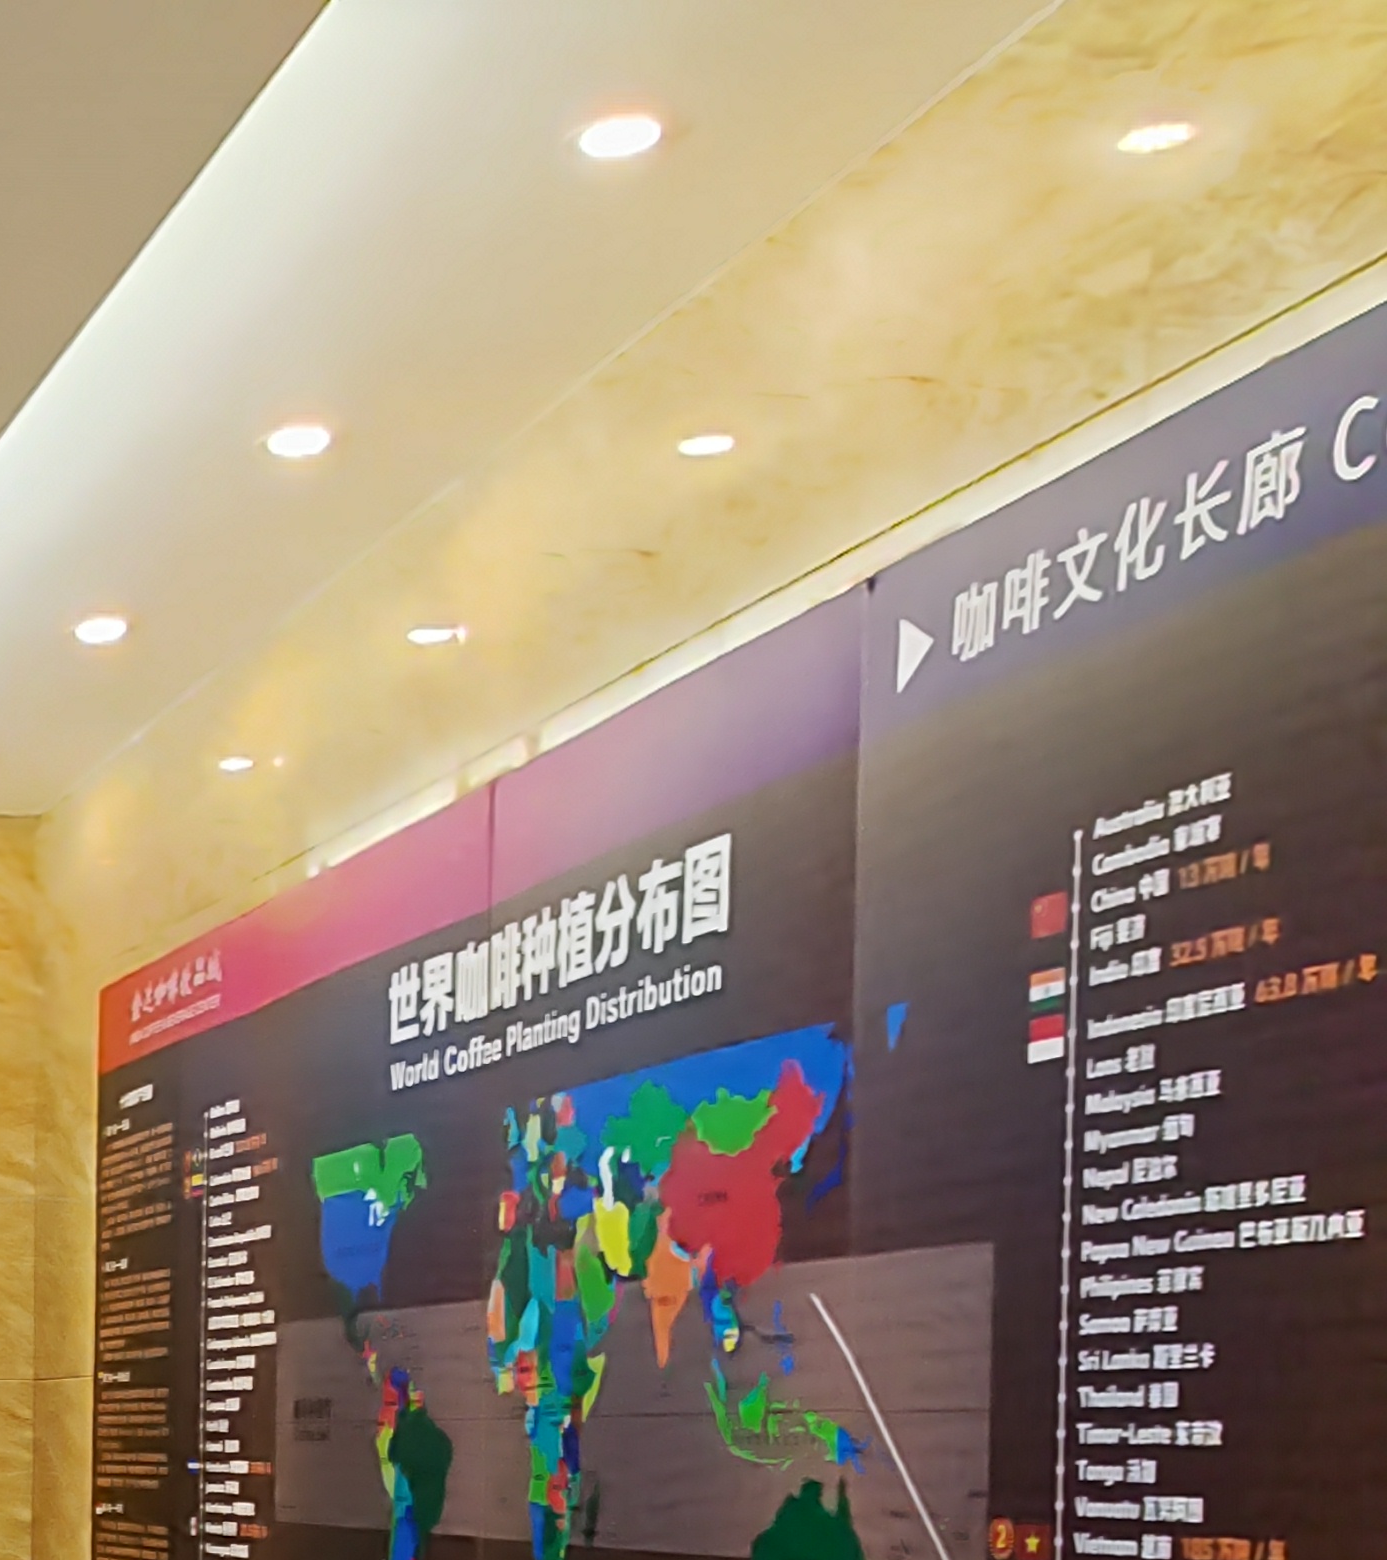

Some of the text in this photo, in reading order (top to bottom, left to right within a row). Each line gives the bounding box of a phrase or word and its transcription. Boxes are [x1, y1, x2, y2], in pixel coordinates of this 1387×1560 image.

[951, 396, 1387, 662] 咖啡文化长廊 C
[1090, 887, 1136, 912] China
[1138, 868, 1170, 900] 中国
[389, 833, 732, 1045] 世界咖啡种植分布图
[1089, 960, 1129, 987] India
[390, 964, 722, 1091] World Coffee Planting Distribution
[1083, 1161, 1129, 1191] Nepal
[1082, 1204, 1119, 1226] New
[1081, 1240, 1130, 1264] Papua
[1132, 1234, 1171, 1256] New
[1078, 1350, 1100, 1371] Sri
[1102, 1348, 1151, 1371] Lanka
[1077, 1385, 1145, 1408] Thailand
[1073, 1532, 1139, 1557] Vietnam
